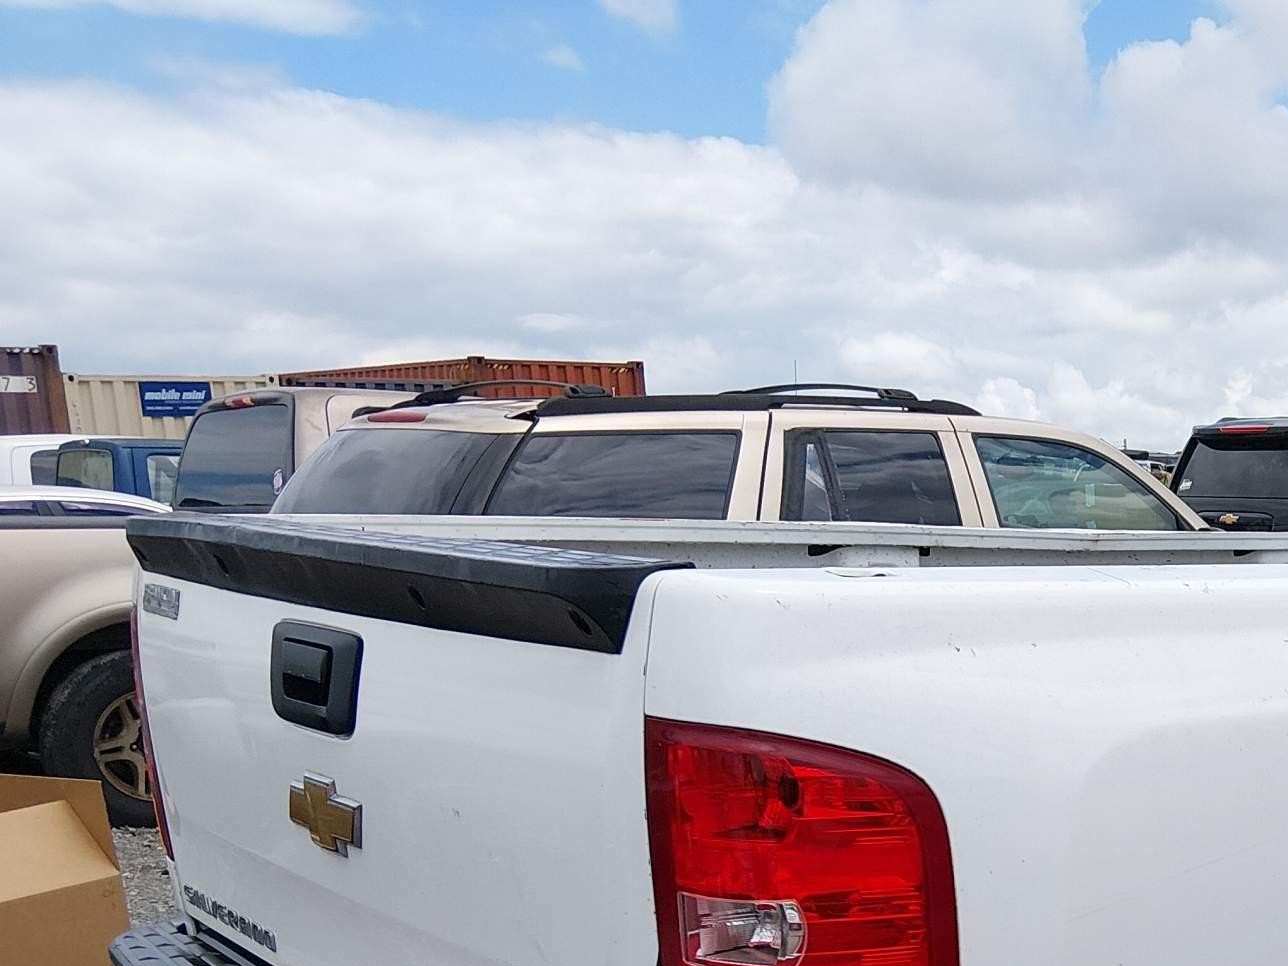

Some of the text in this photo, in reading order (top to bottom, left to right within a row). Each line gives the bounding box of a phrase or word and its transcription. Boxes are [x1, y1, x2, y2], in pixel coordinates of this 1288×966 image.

[144, 388, 207, 401] mobile mini
[183, 884, 278, 953] SILVERADO
